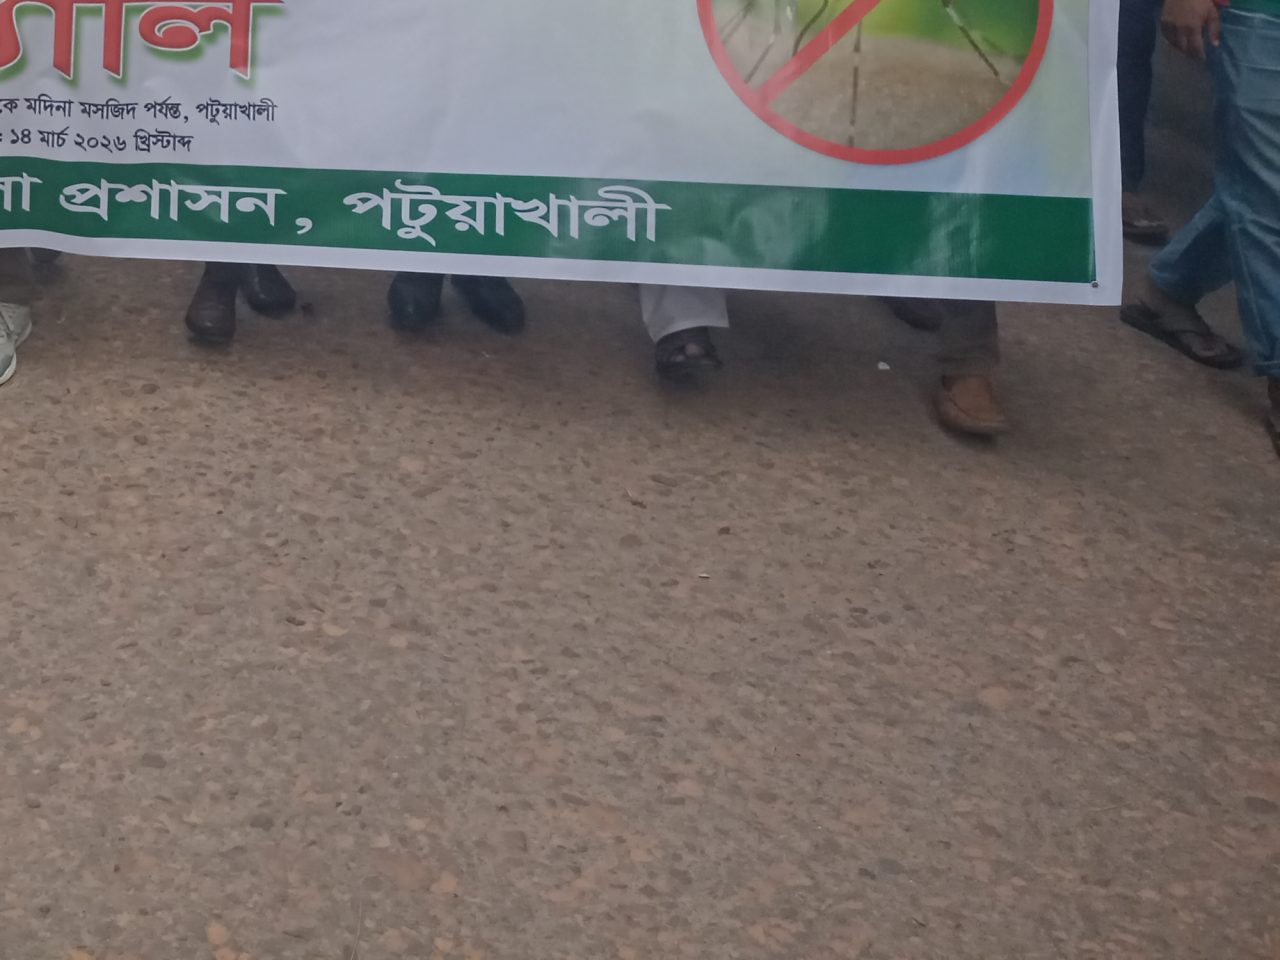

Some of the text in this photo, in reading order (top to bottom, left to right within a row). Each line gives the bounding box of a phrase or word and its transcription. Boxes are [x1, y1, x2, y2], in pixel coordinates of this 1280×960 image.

[26, 95, 73, 117] মদিনা
[80, 98, 137, 121] মসজিদ
[144, 97, 189, 124] পর্যন্ত,
[195, 98, 278, 124] পটুয়াখালী
[10, 128, 32, 146] ১৪
[38, 127, 68, 150] মার্চ
[73, 131, 126, 152] ২০২৬
[132, 128, 194, 154] খ্রিস্টাব্দ
[343, 180, 670, 245] পটুয়াখালী
